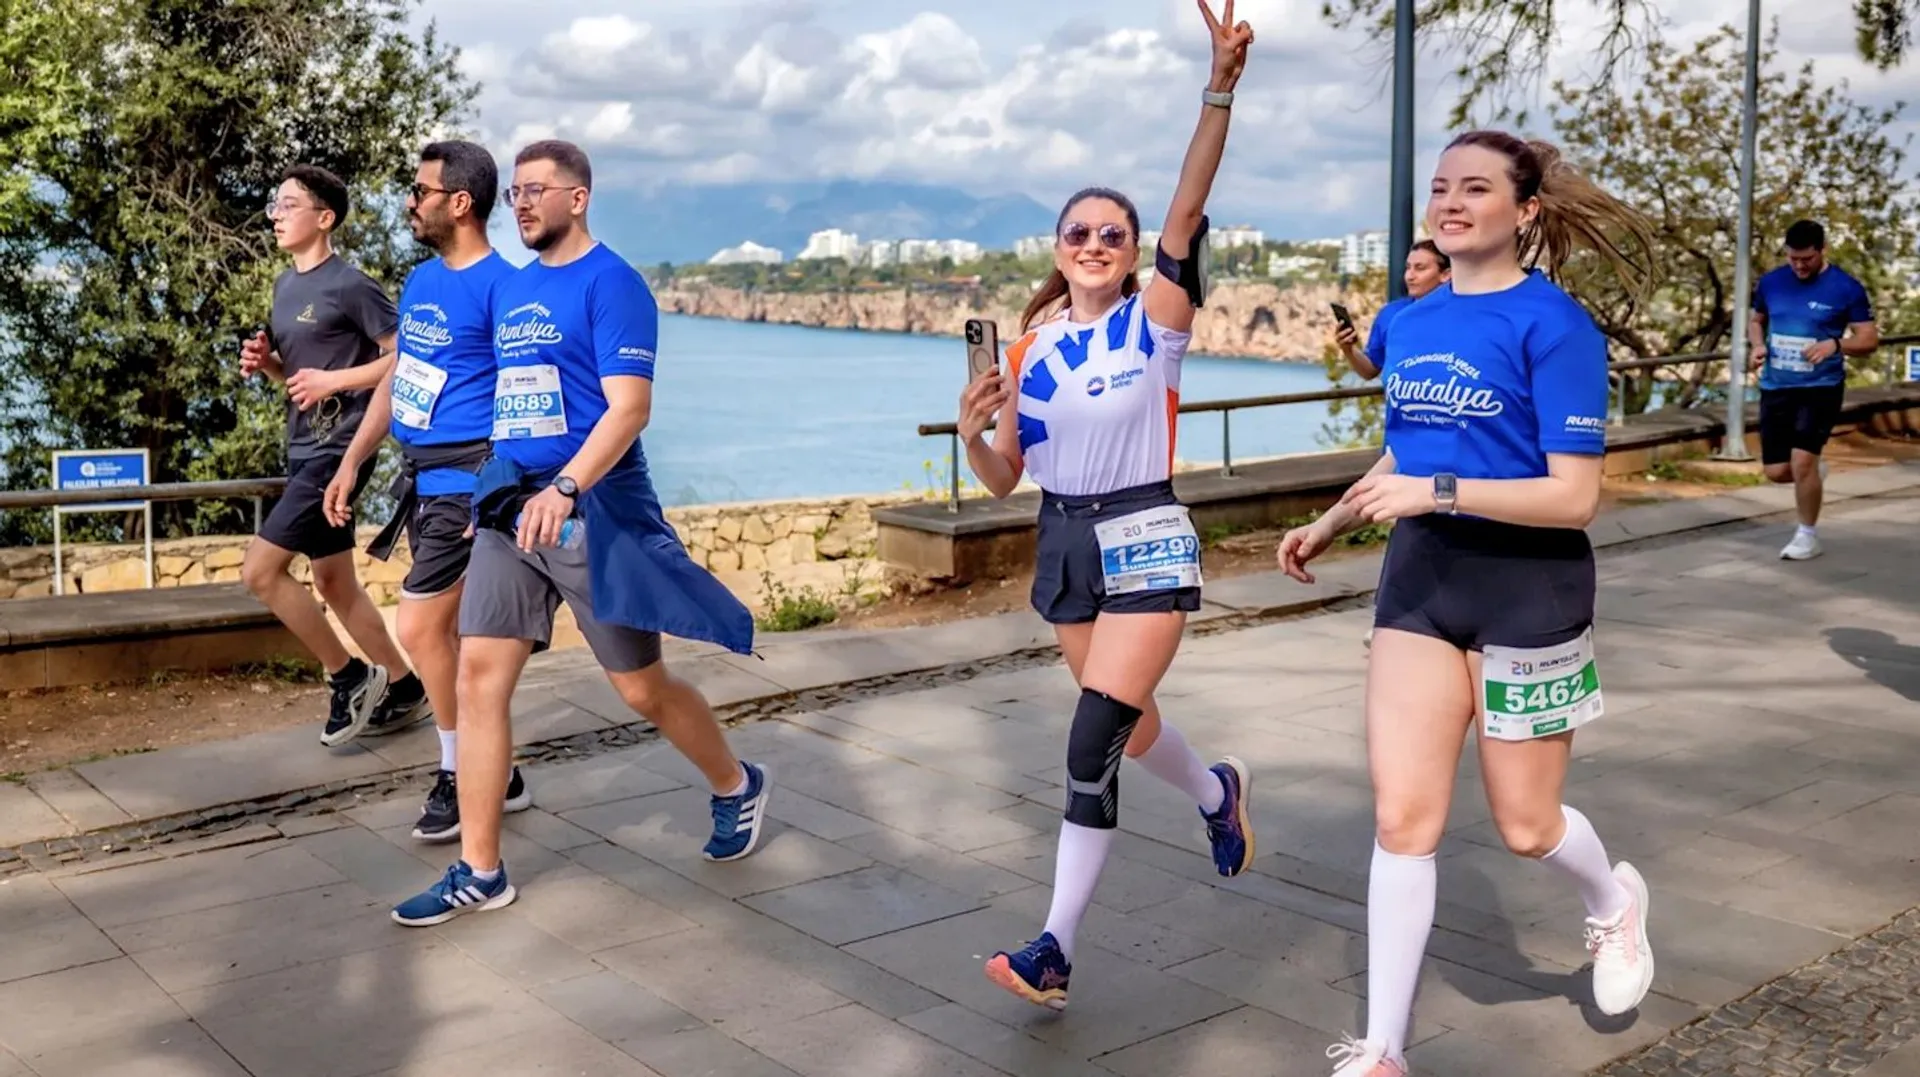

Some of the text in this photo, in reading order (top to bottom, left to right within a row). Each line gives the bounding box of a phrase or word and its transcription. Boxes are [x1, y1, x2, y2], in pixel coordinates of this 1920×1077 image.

[1110, 368, 1144, 381] SunExpress
[393, 377, 429, 405] 10676
[497, 393, 553, 412] 10689
[1387, 373, 1503, 417] Runtalya
[1122, 523, 1142, 538] 20
[1113, 537, 1196, 565] 12299
[1511, 660, 1534, 676] 20
[1505, 672, 1587, 713] 5462
